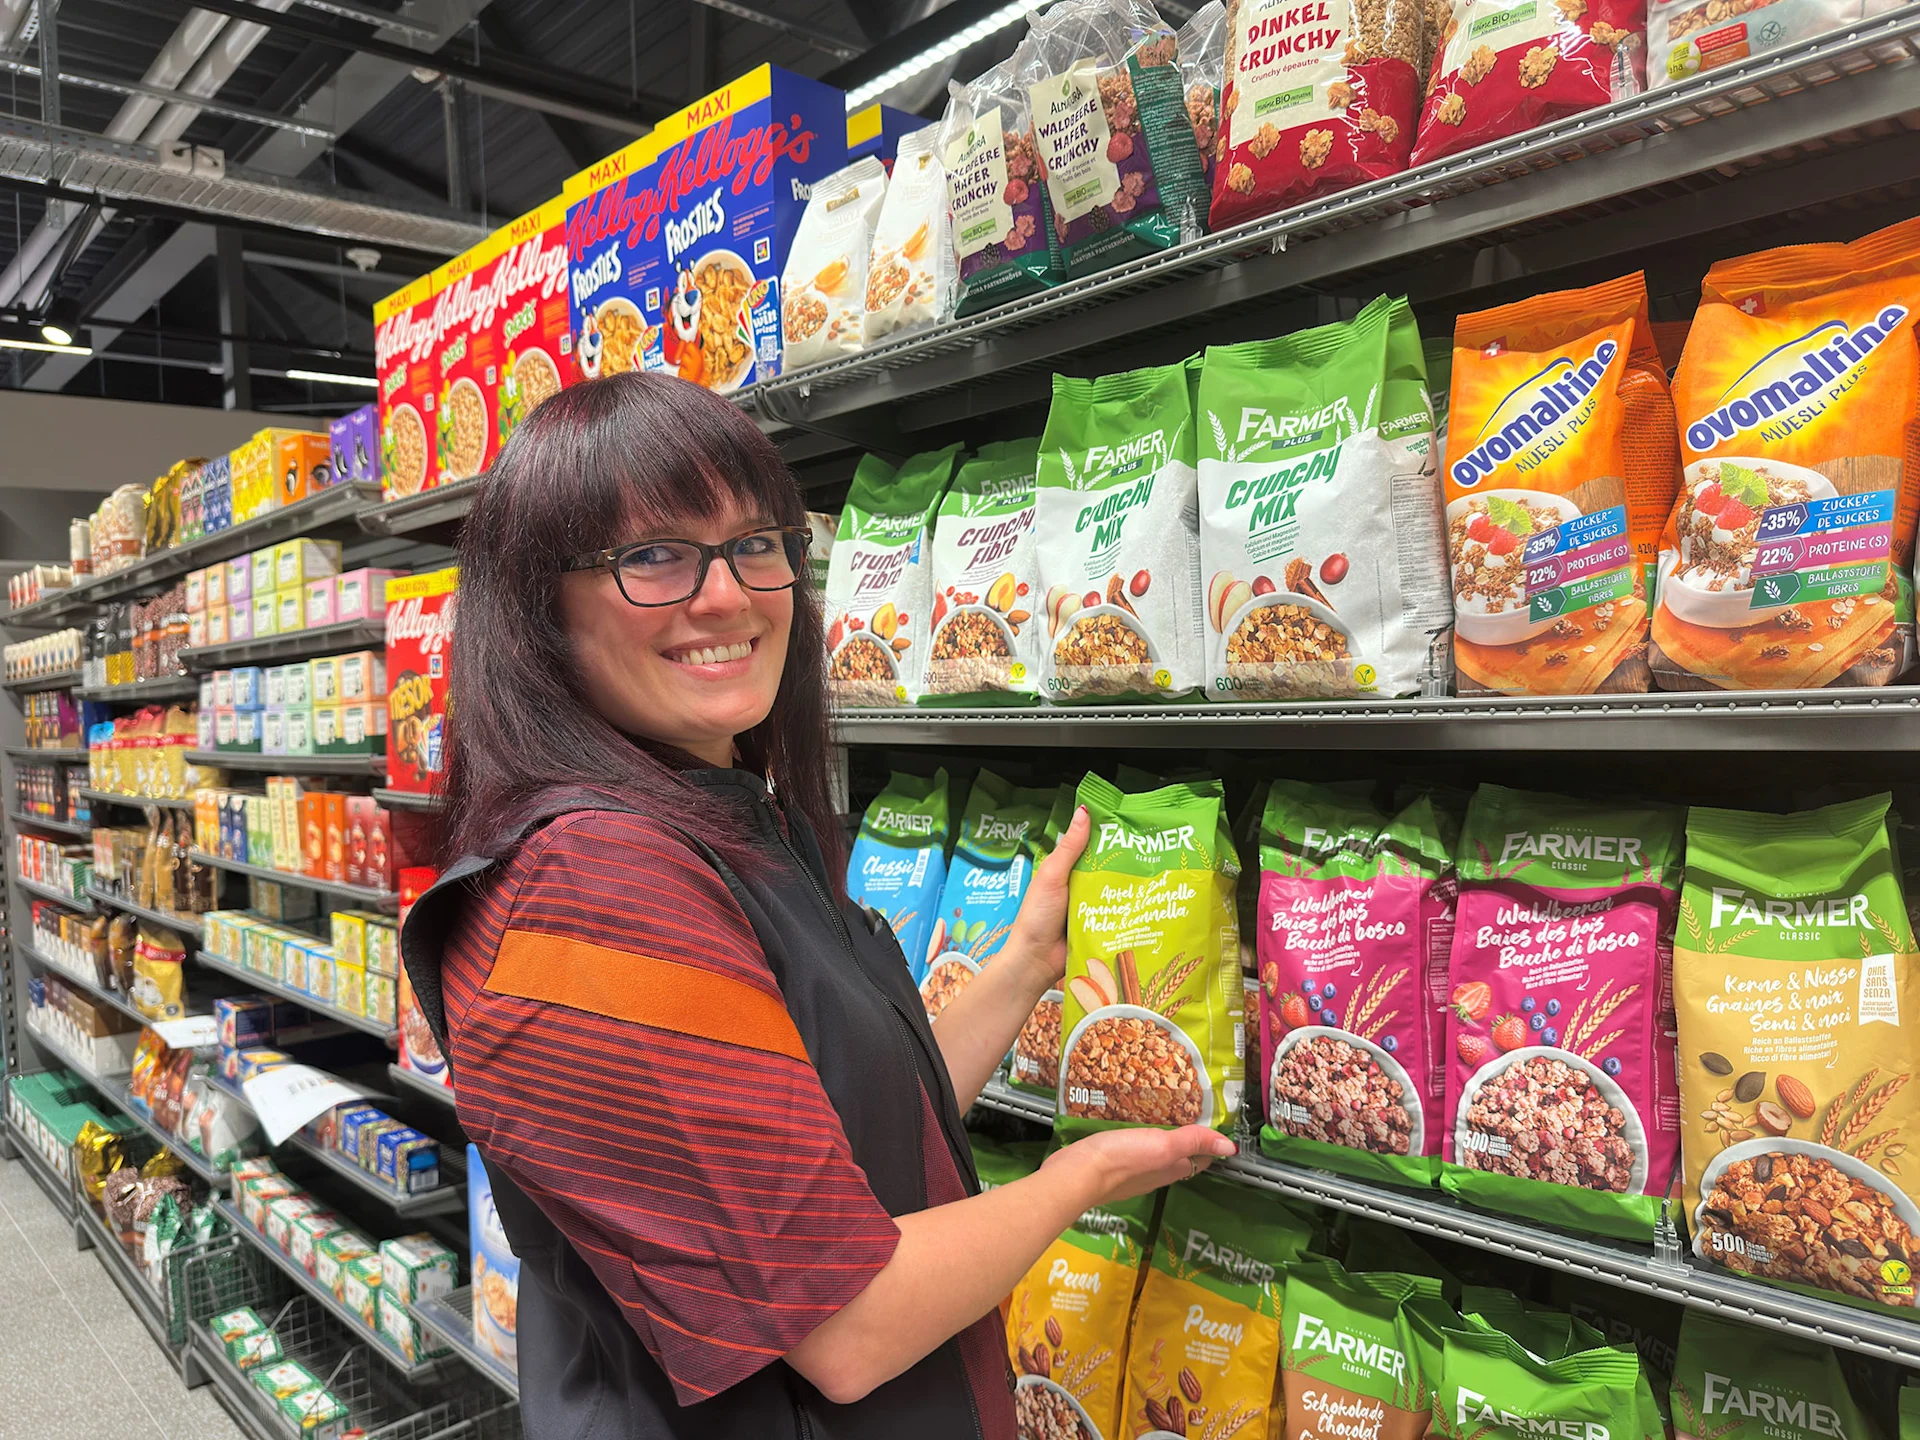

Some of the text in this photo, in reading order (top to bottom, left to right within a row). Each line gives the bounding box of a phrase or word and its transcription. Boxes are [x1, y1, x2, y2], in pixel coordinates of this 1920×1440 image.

[1248, 2, 1330, 45] DINKEL
[1492, 13, 1510, 27] BIO
[1239, 28, 1341, 72] CRUNCHY
[1251, 57, 1320, 84] Crunchy épeautre
[687, 90, 731, 130] MAXI
[1275, 94, 1291, 107] BIO
[1038, 99, 1099, 139] WALDBEERE
[1053, 122, 1090, 153] HAFER
[658, 114, 817, 213] Kellogg's
[946, 148, 1000, 182] WALDBEERE
[1048, 137, 1100, 172] CRUNCHY
[589, 153, 627, 189] MAXI
[954, 167, 990, 194] HAFER
[952, 181, 998, 211] CRUNCHY
[510, 212, 541, 242] MAXI
[665, 186, 726, 264] FROSTIES
[447, 255, 472, 281] MAXI
[572, 241, 622, 307] FROSTIES
[389, 290, 411, 312] MAXI
[753, 309, 777, 328] win
[1687, 306, 1907, 450] ovomaltine
[1829, 364, 1868, 401] PLUS
[1236, 396, 1348, 443] FARMER
[1380, 411, 1431, 436] FARMER
[1452, 341, 1617, 487] ovomaltine
[1567, 397, 1597, 434] PLUS
[1083, 429, 1164, 474] FARMER
[1282, 434, 1313, 449] PLUS
[1117, 462, 1137, 475] PLUS
[1225, 444, 1344, 510] Crunchy
[1002, 495, 1023, 506] PLUS
[1075, 474, 1157, 534] Crunchy
[1822, 493, 1877, 512] ZUCKER-
[1272, 525, 1301, 539] Magnesium
[1570, 510, 1612, 532] ZUCKER-
[1761, 510, 1801, 531] -35%
[1817, 509, 1880, 529] DE SUCRES
[1526, 535, 1556, 554] -35%
[1569, 524, 1618, 547] DE SUCRES
[1808, 534, 1889, 558] PROTEINE (S)
[966, 534, 1018, 570] Fibre
[1567, 544, 1628, 573] PROTEINE (S)
[1761, 545, 1794, 567] 22%
[1529, 565, 1557, 586] 22%
[1570, 570, 1629, 597] BALLASTSTOFFE
[1807, 564, 1882, 585] BALLASTSTOFFE
[1588, 589, 1614, 604] FIBRES
[1827, 582, 1860, 596] FIBRES
[923, 671, 938, 685] 600
[1047, 677, 1071, 692] 600
[1215, 677, 1243, 692] 600
[872, 806, 933, 836] FARMER
[1096, 823, 1196, 856] FARMER
[1499, 831, 1643, 867] FARMER
[862, 855, 915, 876] Classic
[1135, 853, 1162, 864] CLASSIC
[1551, 861, 1588, 872] CLASSIC
[1100, 883, 1145, 904] Apfel &
[1077, 901, 1132, 919] Pommes
[1133, 902, 1142, 914] &
[1083, 905, 1190, 933] Mela & cannella
[1271, 903, 1368, 933] Baies des bois
[1496, 896, 1614, 926] Waldbeeren
[1710, 886, 1876, 930] FARMER
[1284, 921, 1406, 951] Bacche di bosco
[1475, 915, 1606, 949] Baies des bois
[1779, 931, 1821, 941] CLASSIC
[1498, 931, 1640, 969] Bacche di bosco
[1724, 966, 1858, 995] Kerne & Nüsse
[1865, 976, 1888, 987] SANS
[1867, 965, 1887, 976] OHNE
[1706, 989, 1845, 1014] Graines & noix
[1863, 988, 1891, 998] SENZA
[1749, 1006, 1852, 1033] Semi & noci
[1743, 1046, 1763, 1054] Riche
[1775, 1045, 1797, 1053] fibres
[1798, 1040, 1838, 1052] alimentaires
[1752, 1037, 1772, 1046] Reich
[1750, 1050, 1832, 1063] Ricco di fibre alimentari
[1068, 1086, 1089, 1104] 500
[1463, 1130, 1489, 1152] 500
[1076, 1206, 1129, 1248] RMER
[1712, 1232, 1744, 1256] 500
[1048, 1258, 1102, 1295] Pecan
[1182, 1228, 1276, 1298] FARMER
[1883, 1286, 1913, 1295] VEGAN
[1183, 1304, 1244, 1348] Pecan
[1292, 1312, 1407, 1387] FARMER
[1341, 1362, 1372, 1379] CLASSIC
[1302, 1390, 1385, 1421] Schokolade
[1457, 1386, 1610, 1440] FARMER
[1702, 1372, 1847, 1440] FARMER
[1317, 1412, 1383, 1440] Chocolat
[1763, 1426, 1803, 1440] CLASSIC
